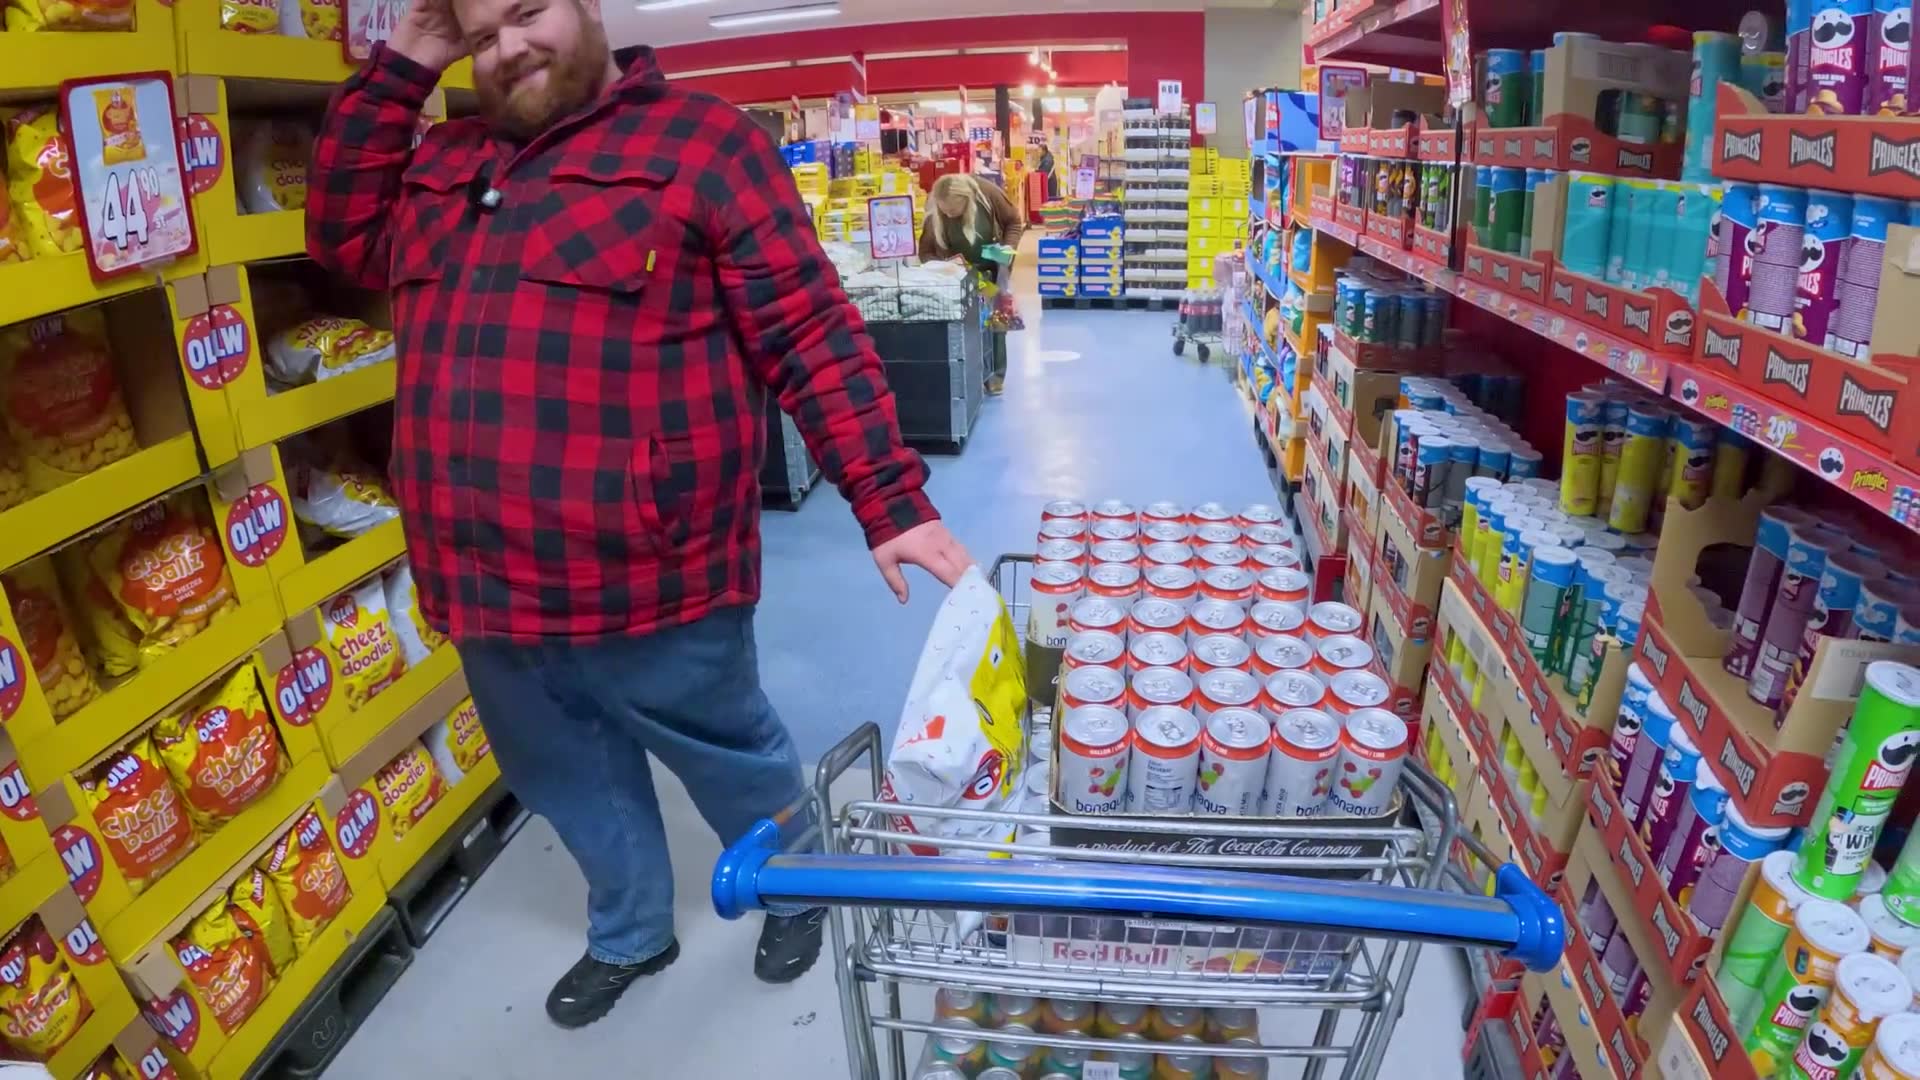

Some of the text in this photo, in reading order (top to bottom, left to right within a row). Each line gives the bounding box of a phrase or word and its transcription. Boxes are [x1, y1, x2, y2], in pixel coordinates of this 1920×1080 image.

[1811, 48, 1852, 69] PRINGLES
[1880, 47, 1908, 68] PRIN
[1725, 131, 1760, 161] PRINGLES
[1791, 135, 1834, 167] PRINGLES
[103, 172, 149, 250] 44
[1705, 328, 1740, 365] PRINGLES
[1766, 349, 1808, 393] PRINGLES
[1840, 379, 1893, 431] PRINGLES
[1851, 469, 1888, 492] Pringles
[339, 621, 386, 661] cheez
[342, 639, 392, 676] doodles
[1680, 682, 1708, 731] PRINGLES
[198, 709, 228, 743] OLW
[384, 761, 426, 806] doodles
[1720, 738, 1755, 795] PRINGLES
[101, 780, 174, 838] cheez
[1329, 787, 1378, 816] bonaqua
[1772, 801, 1802, 815] PRINGLES
[121, 808, 178, 853] ballz
[300, 817, 322, 847] OLW
[1090, 839, 1156, 852] product
[1157, 841, 1181, 854] of
[1182, 837, 1216, 854] The
[1289, 839, 1361, 857] Company
[1054, 942, 1169, 966] Red Bull
[1695, 999, 1728, 1060] PRINGLES
[1773, 1007, 1808, 1028] PRING
